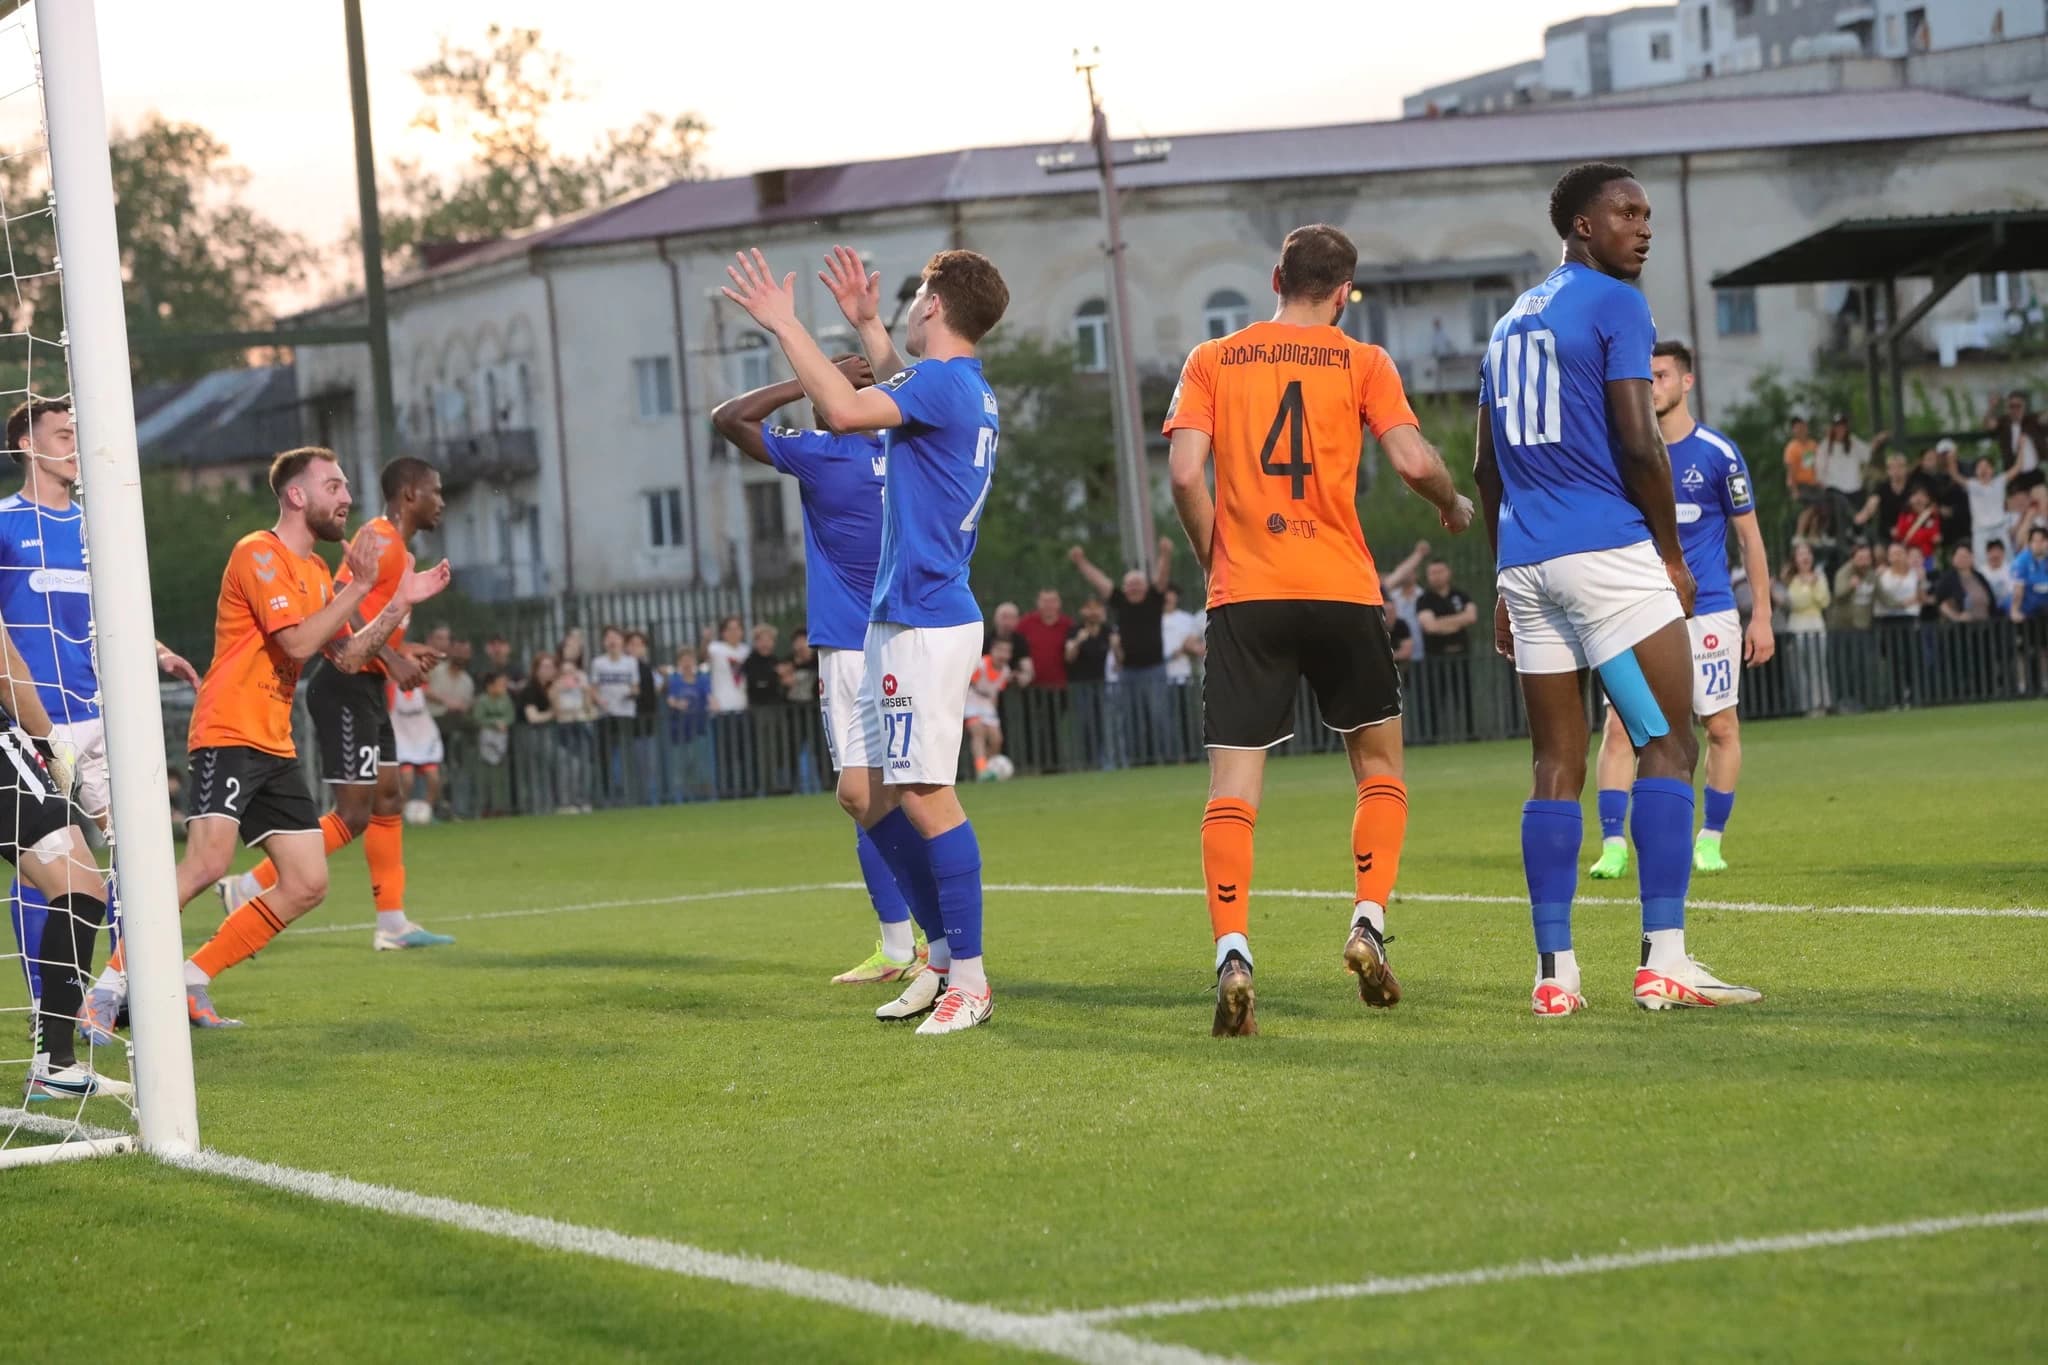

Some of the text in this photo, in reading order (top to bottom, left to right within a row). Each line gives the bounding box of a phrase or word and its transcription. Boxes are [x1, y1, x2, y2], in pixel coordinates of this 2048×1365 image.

[1490, 329, 1561, 446] 40
[1260, 380, 1312, 500] 4
[1702, 659, 1731, 696] 23
[881, 696, 913, 708] ARSBET
[884, 712, 913, 758] 27
[892, 760, 911, 769] JAKO
[224, 777, 240, 811] 2
